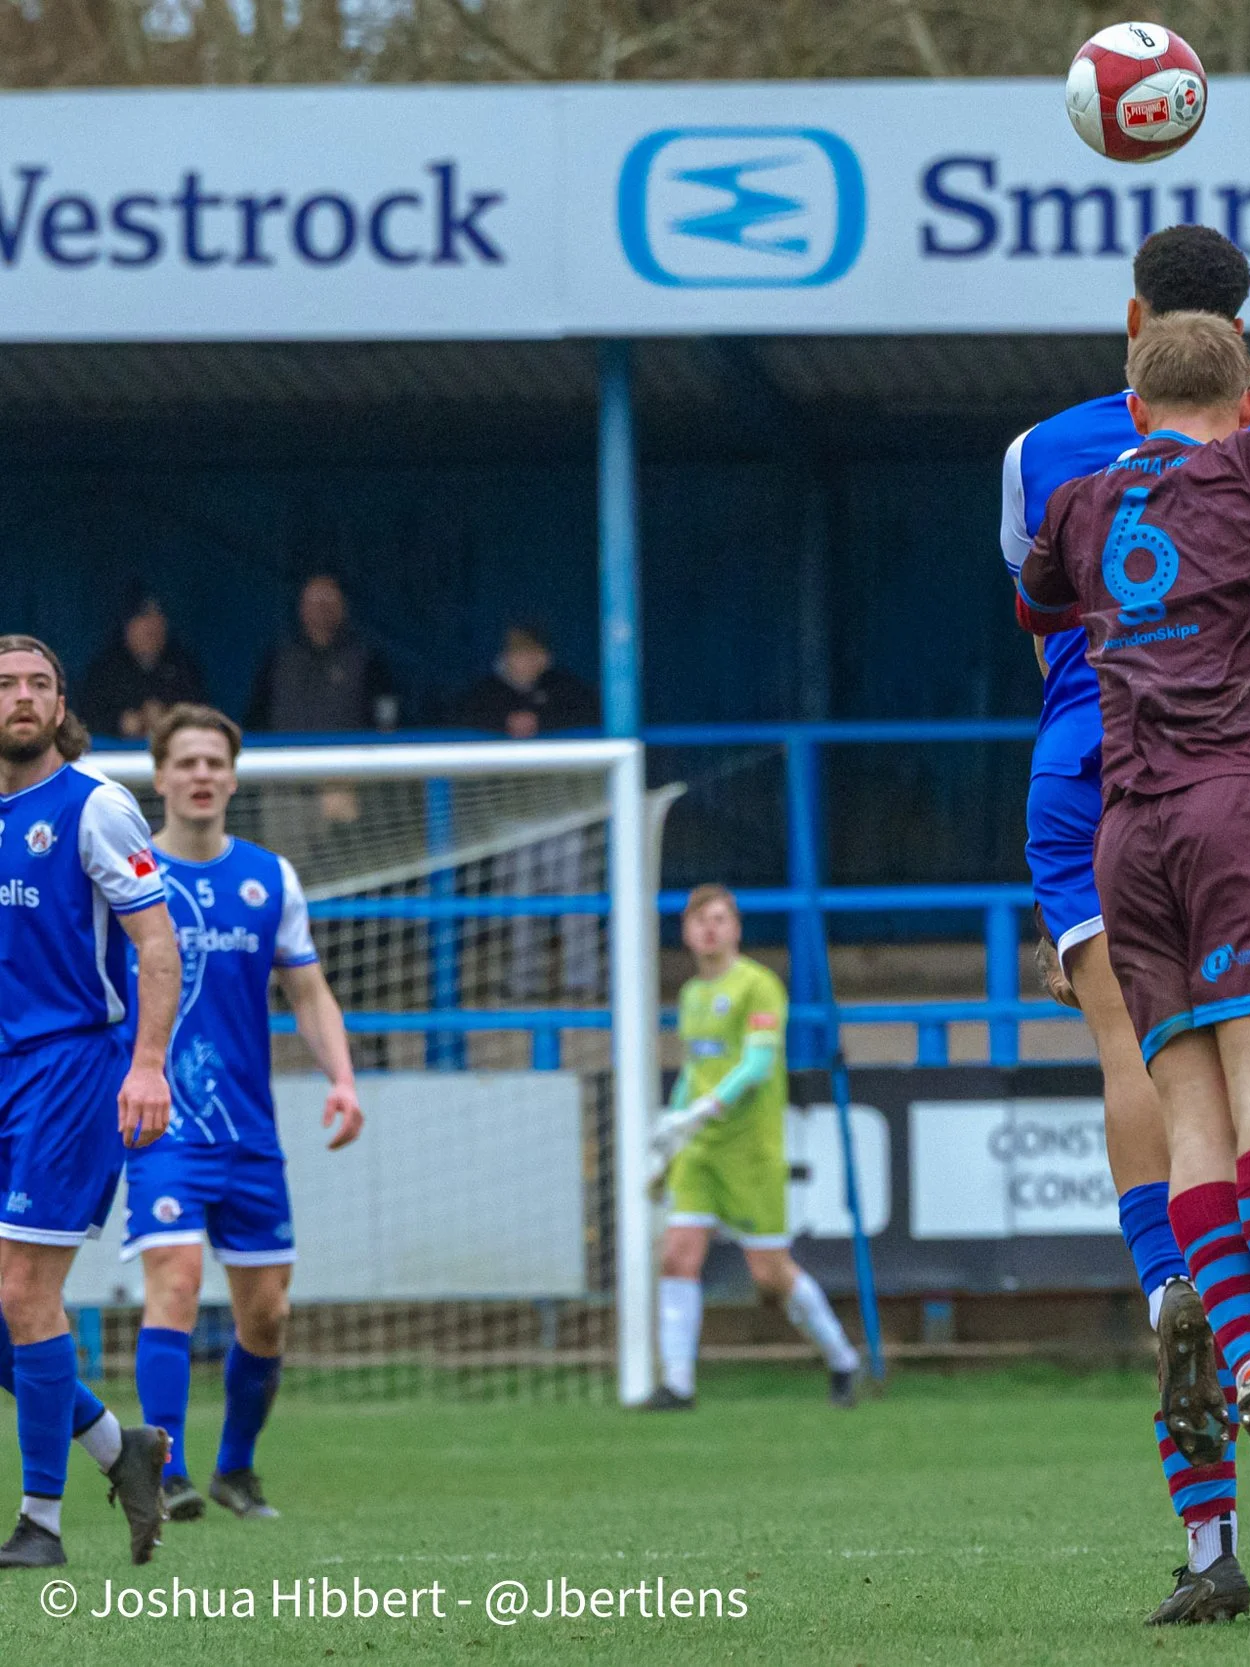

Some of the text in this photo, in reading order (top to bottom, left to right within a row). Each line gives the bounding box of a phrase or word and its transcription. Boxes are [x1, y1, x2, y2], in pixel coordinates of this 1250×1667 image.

[1102, 487, 1180, 626] 6
[195, 878, 215, 909] 5
[180, 926, 260, 954] Fidelis
